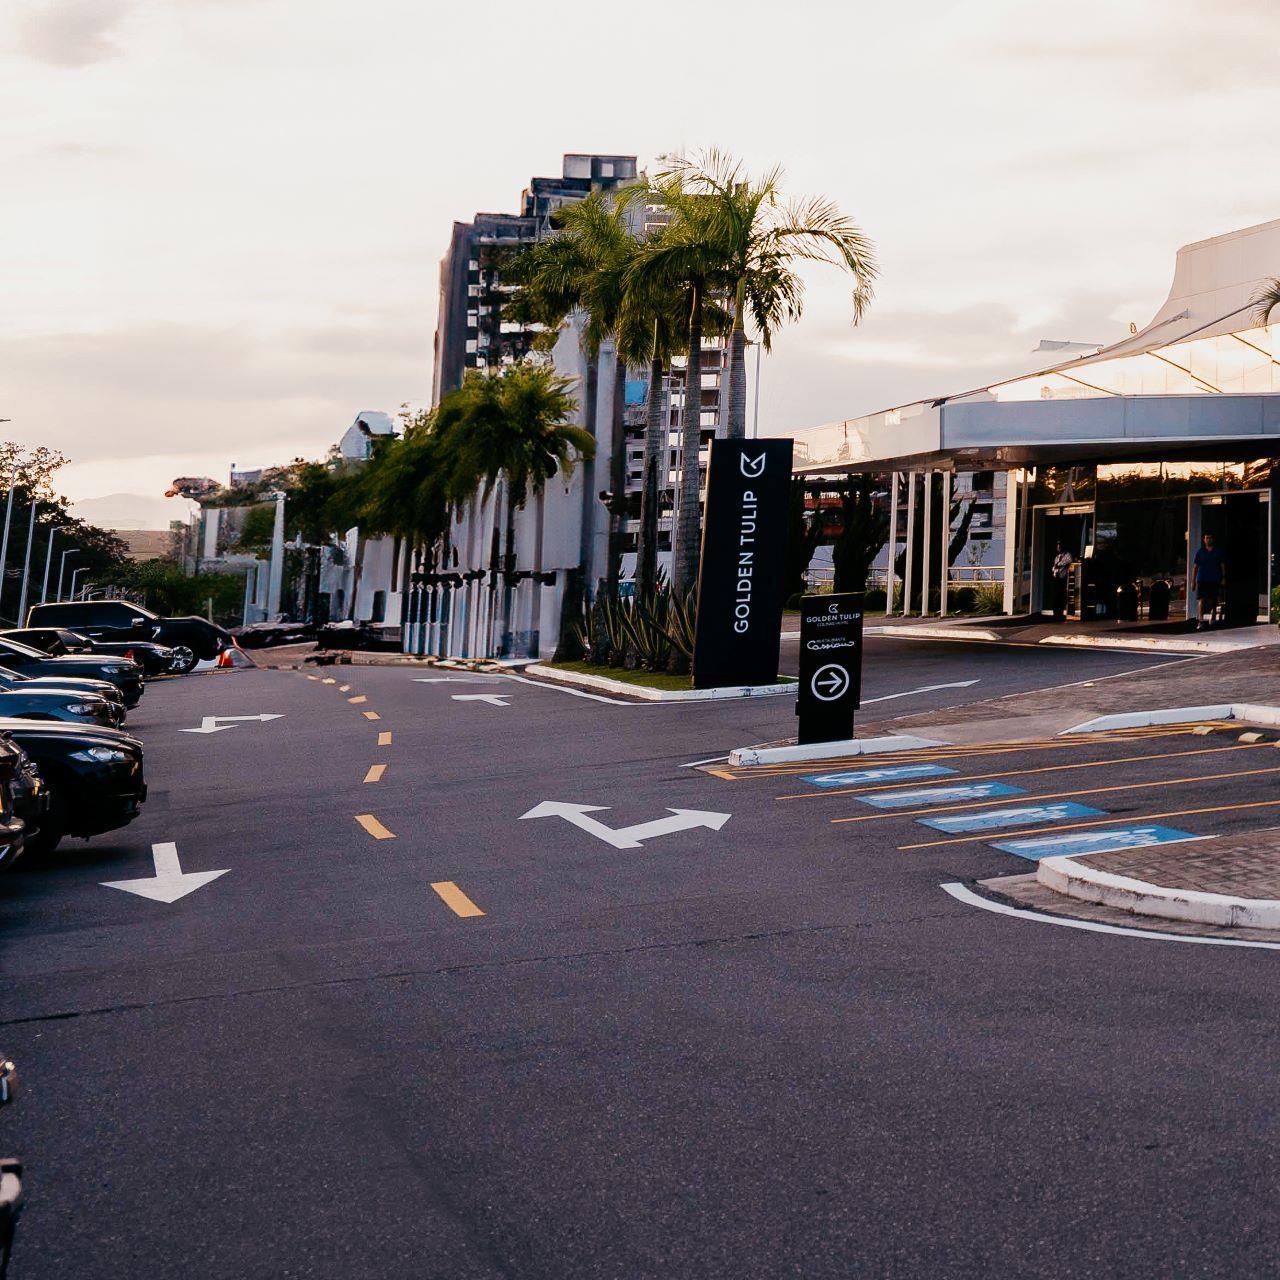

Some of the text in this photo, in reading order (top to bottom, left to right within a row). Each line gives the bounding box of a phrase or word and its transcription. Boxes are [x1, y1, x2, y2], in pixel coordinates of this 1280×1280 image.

[734, 490, 758, 633] GOLDEN TULIP
[806, 612, 860, 623] GOLDEN TULIP
